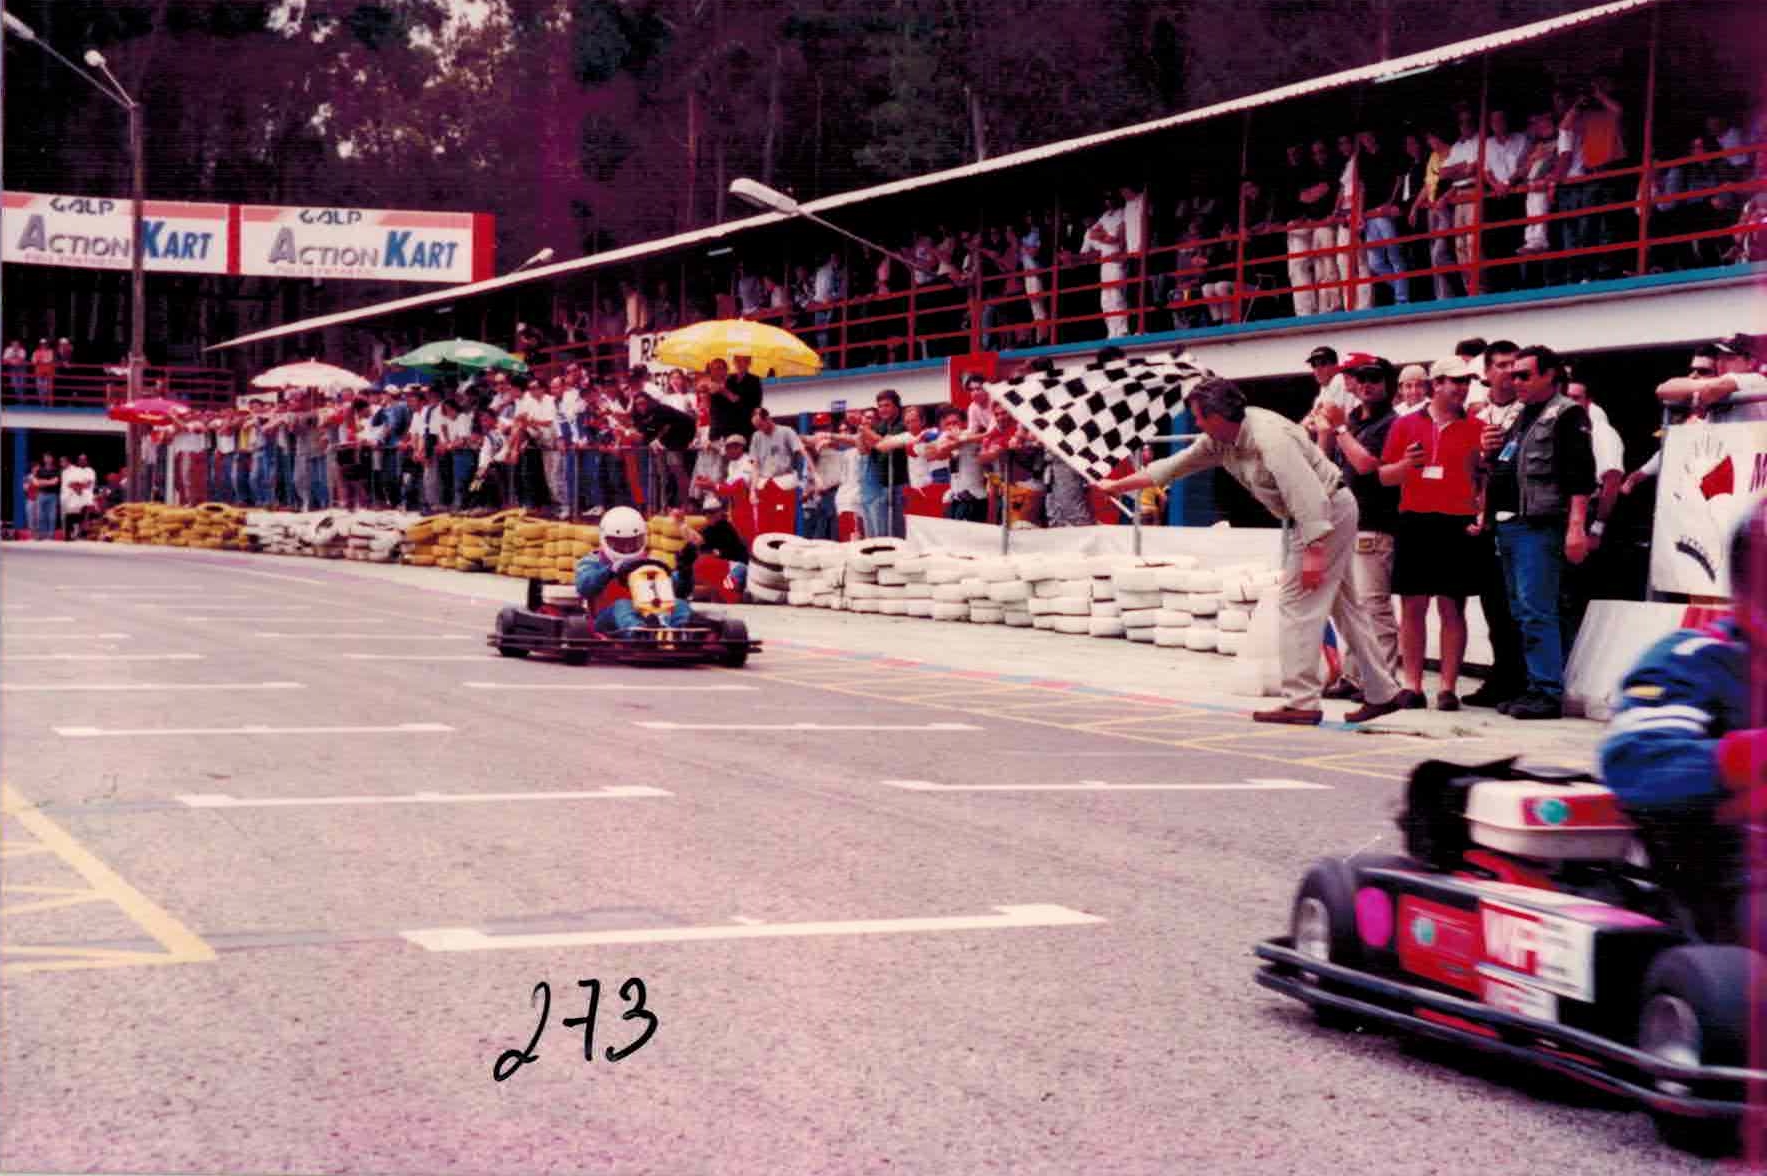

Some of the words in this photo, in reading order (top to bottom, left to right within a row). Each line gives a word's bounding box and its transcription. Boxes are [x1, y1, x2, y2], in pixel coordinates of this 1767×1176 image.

[18, 213, 131, 257] ACTION
[142, 219, 214, 260] KART
[268, 226, 378, 267] ACTION
[383, 229, 459, 270] KART
[493, 977, 659, 1082] 273
